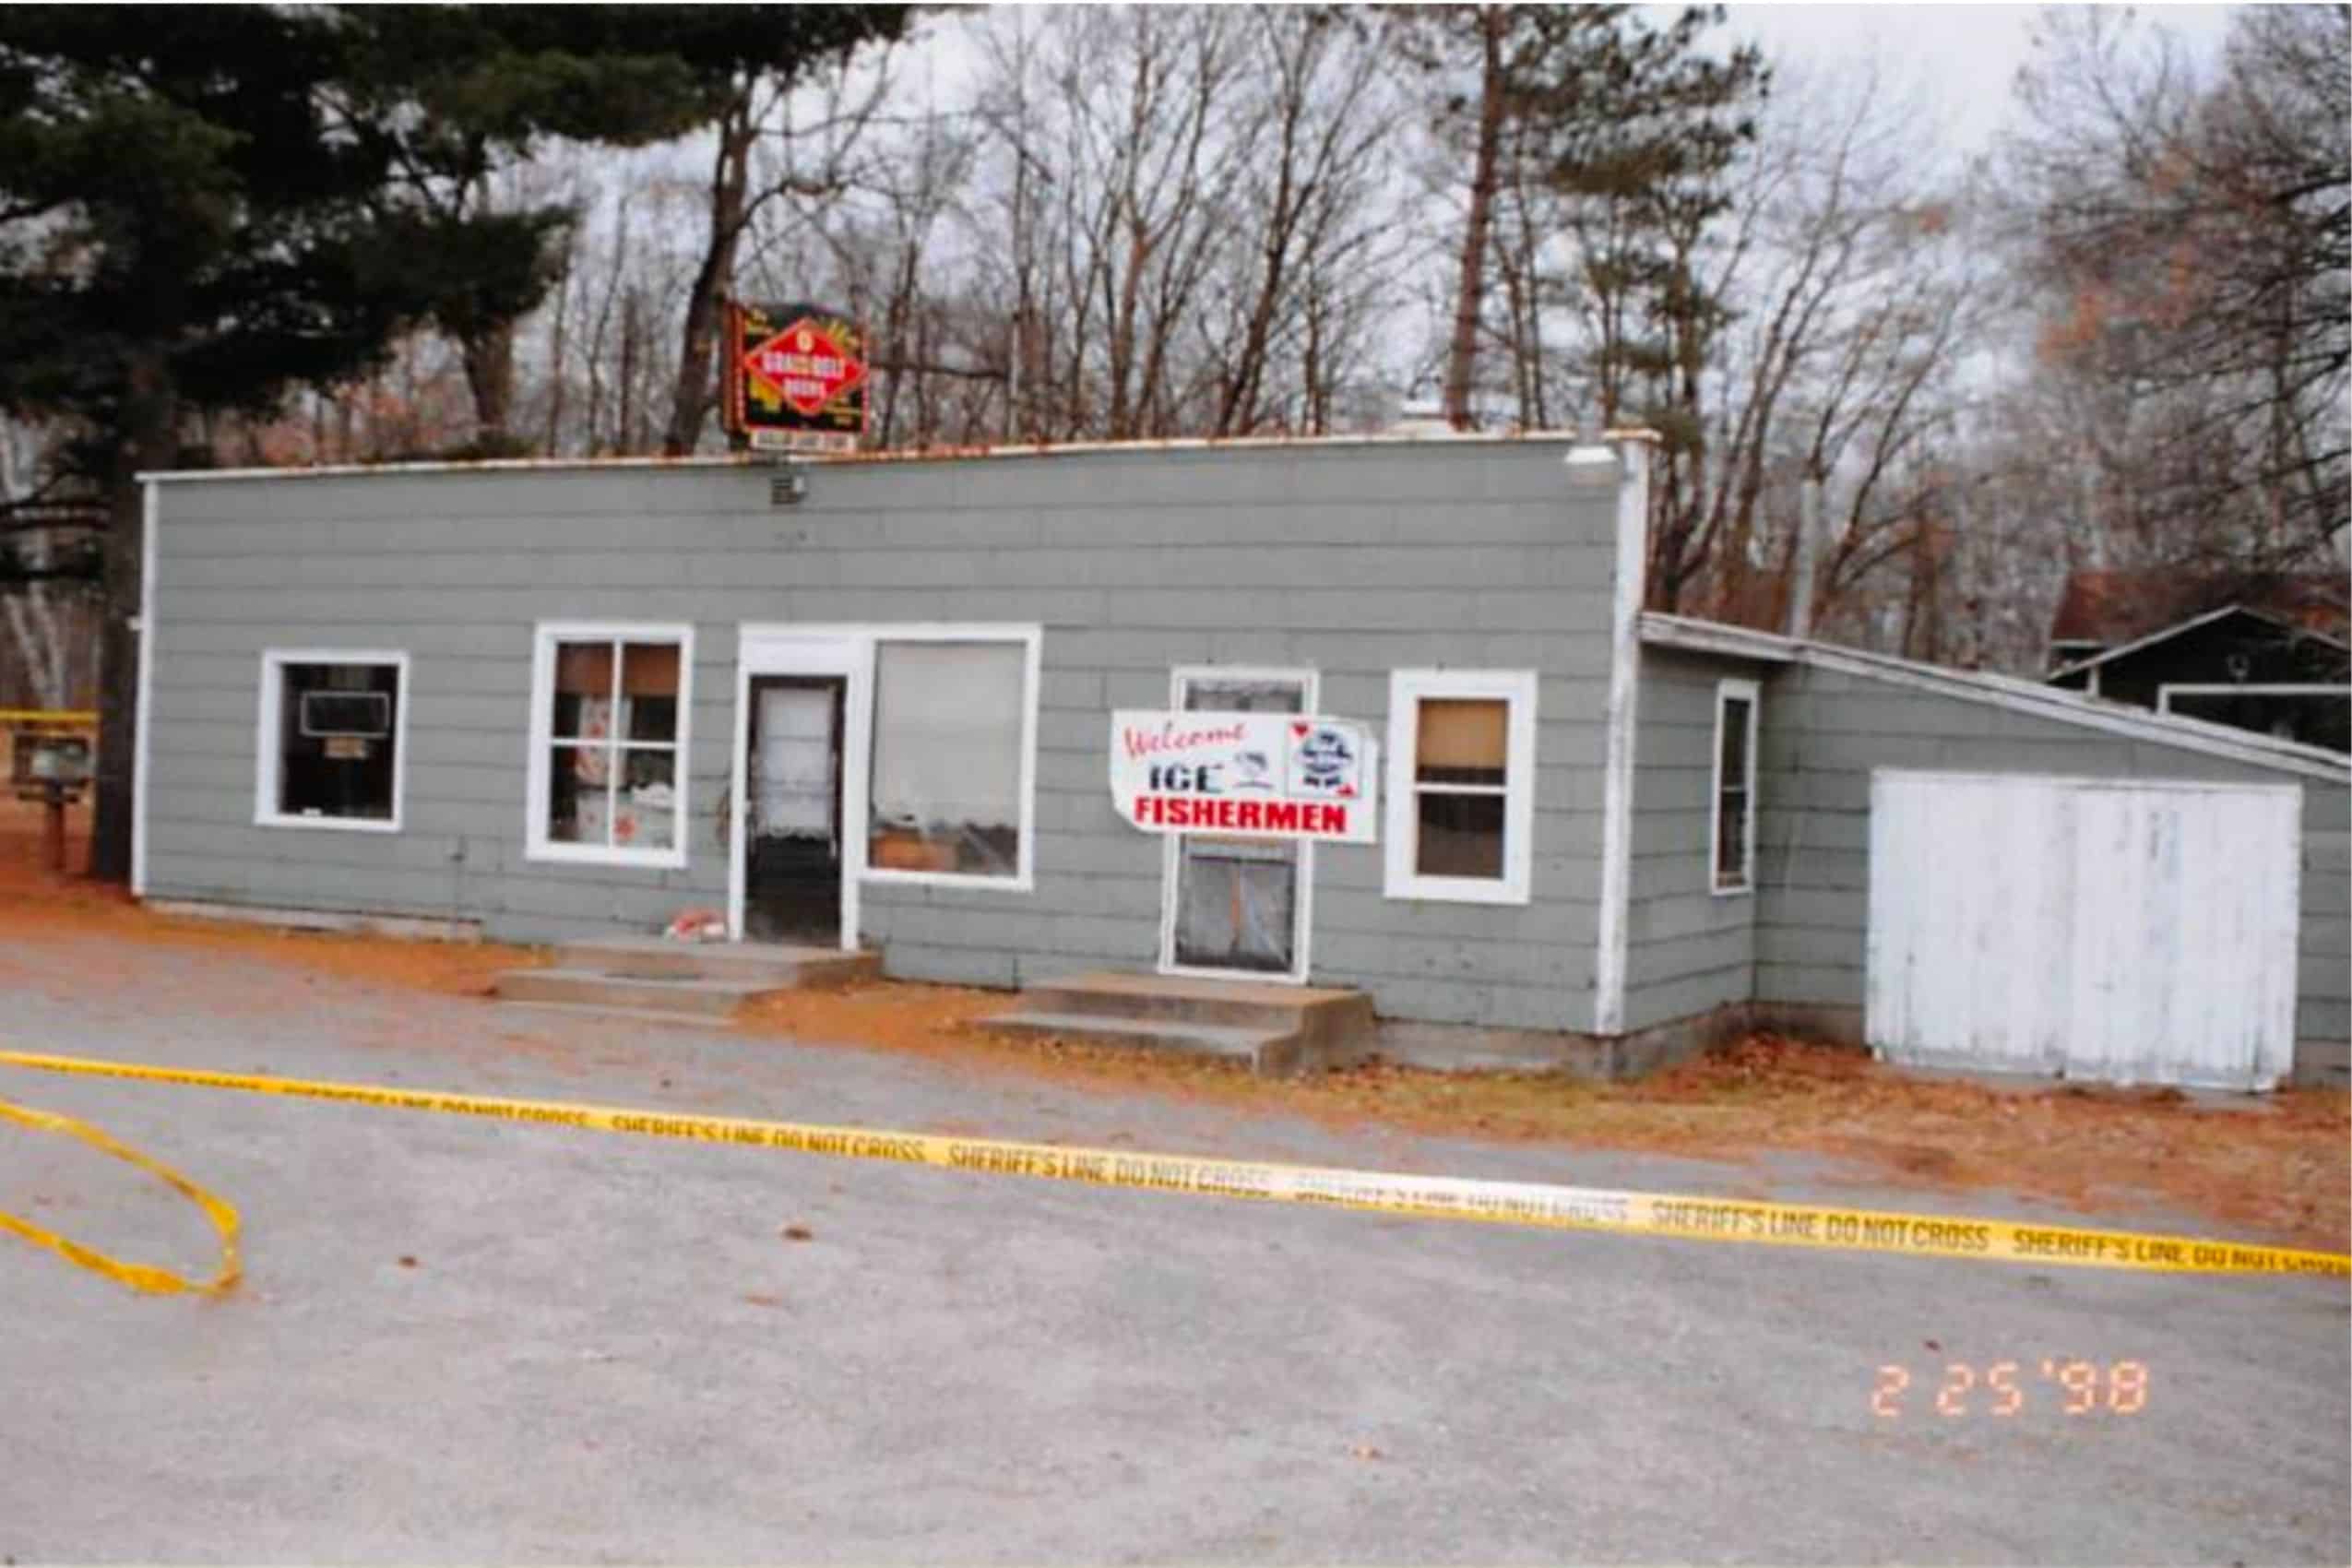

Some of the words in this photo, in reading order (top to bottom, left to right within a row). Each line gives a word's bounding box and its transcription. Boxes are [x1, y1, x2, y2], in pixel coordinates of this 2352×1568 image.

[1123, 721, 1247, 759] Welcome
[1148, 762, 1225, 794] ICE
[1134, 796, 1348, 834] FISHERMEN
[722, 1124, 766, 1146] LINE
[772, 1128, 803, 1149] DO
[808, 1132, 849, 1154] NOT
[852, 1135, 926, 1163] CROSS
[947, 1143, 1057, 1178] SHERIFF'S
[1061, 1154, 1107, 1184] LINE
[1114, 1157, 1146, 1187] DO
[1150, 1160, 1193, 1191] NOT
[1197, 1165, 1271, 1198] CROSS
[1651, 1200, 1764, 1235] SHERIFF'S
[1770, 1210, 1821, 1241] LINE
[1825, 1214, 1859, 1243] DO
[1863, 1218, 1911, 1247] NOT
[1912, 1220, 1991, 1252] CROSS
[2013, 1229, 2130, 1262] SHERIFF'S
[2136, 1239, 2185, 1264] LINE
[2192, 1243, 2226, 1265] DO
[2231, 1248, 2276, 1270] NOT
